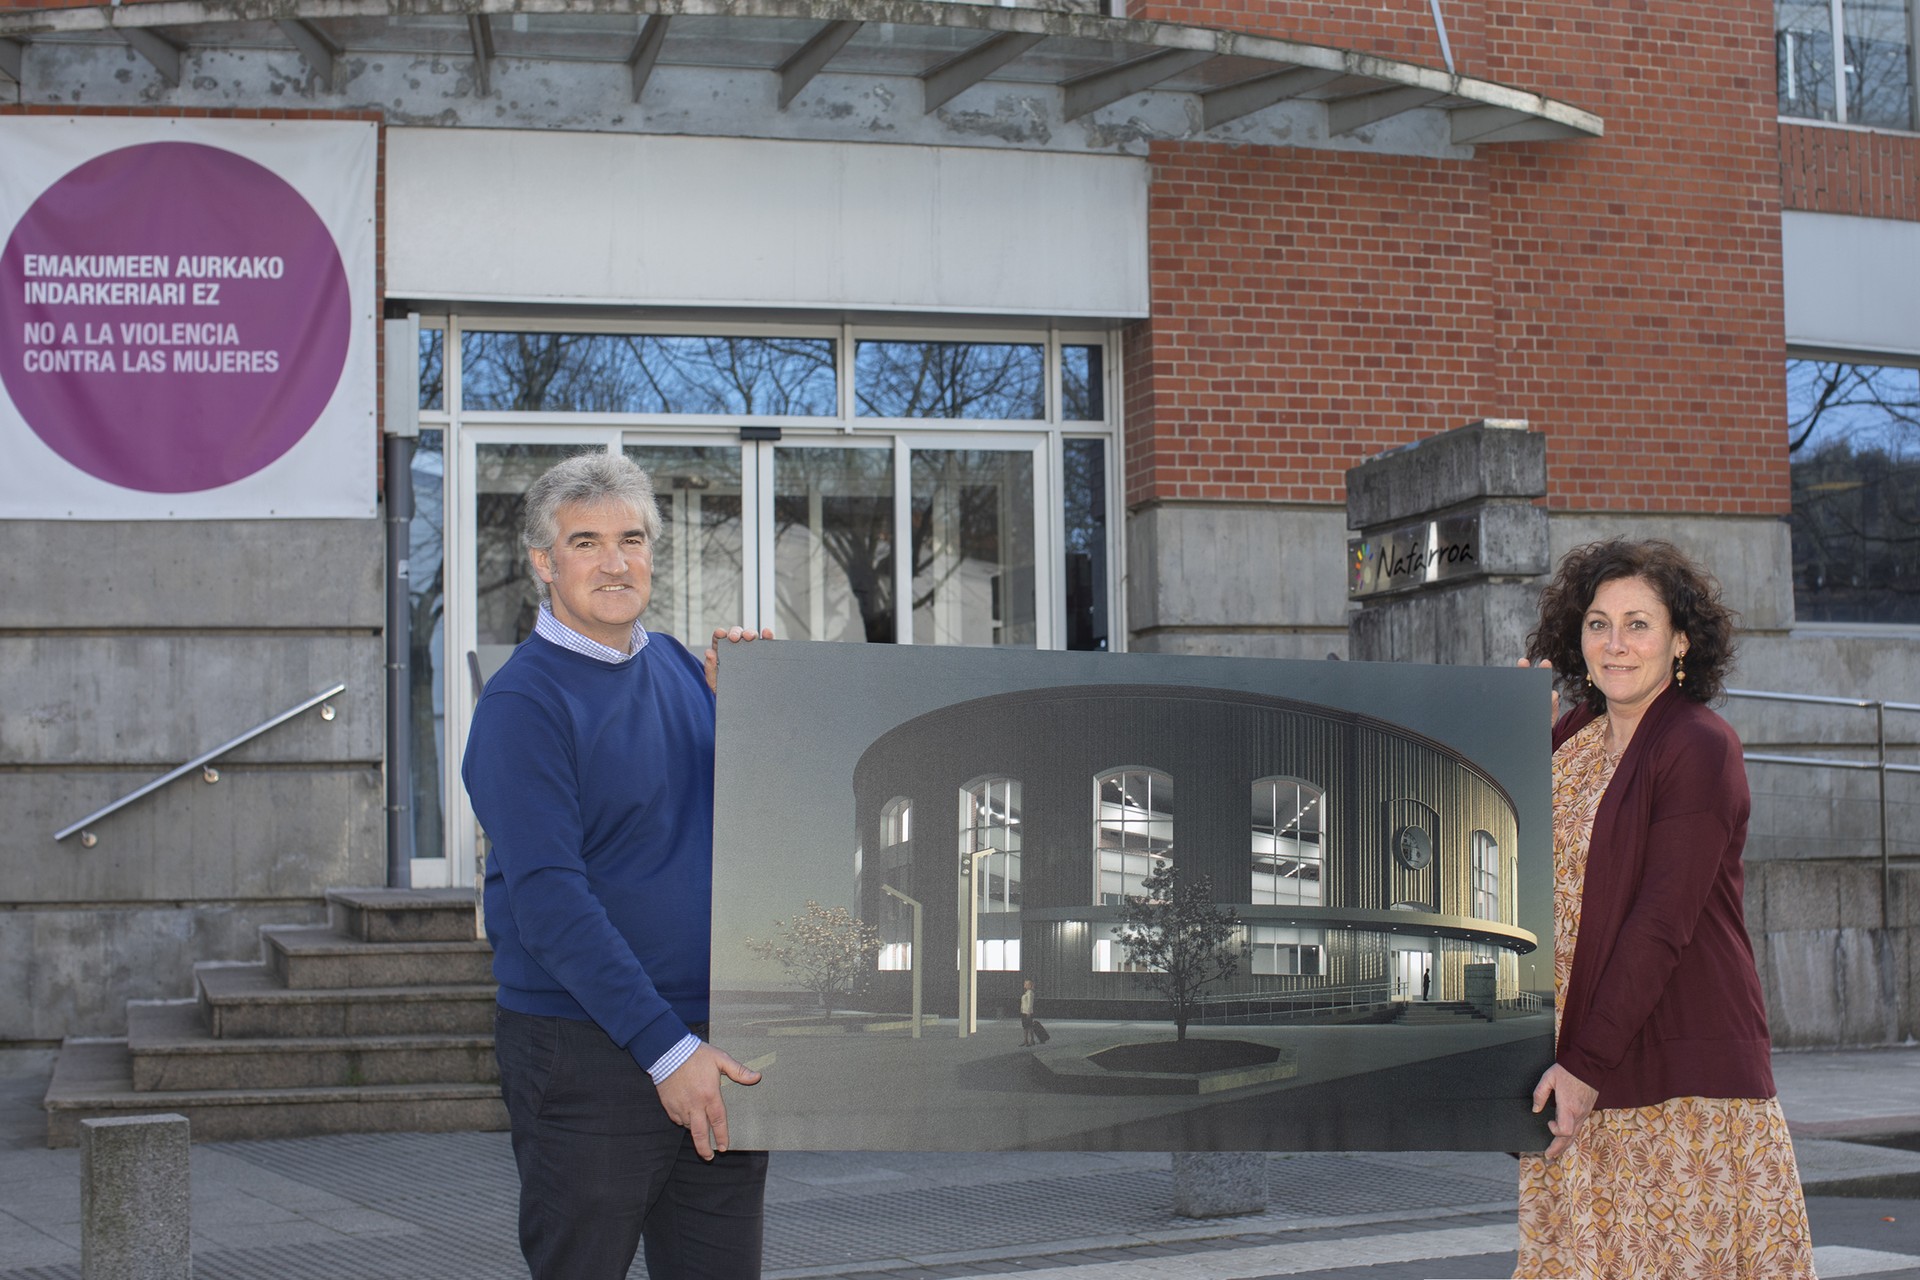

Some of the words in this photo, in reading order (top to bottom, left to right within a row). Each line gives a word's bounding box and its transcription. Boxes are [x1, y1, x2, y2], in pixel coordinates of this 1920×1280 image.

[23, 254, 169, 278] EMAKUMEEN
[175, 256, 284, 279] AURKAKO
[24, 282, 186, 305] INDARKERIARI
[192, 285, 220, 306] EZ
[24, 322, 56, 345] NO
[61, 323, 78, 345] A
[84, 323, 113, 345] LA
[120, 323, 239, 345] VIOLENCIA
[23, 350, 116, 373] CONTRA
[122, 351, 167, 373] LAS
[173, 351, 279, 373] MUJERES
[1377, 542, 1474, 578] Nafarroa
